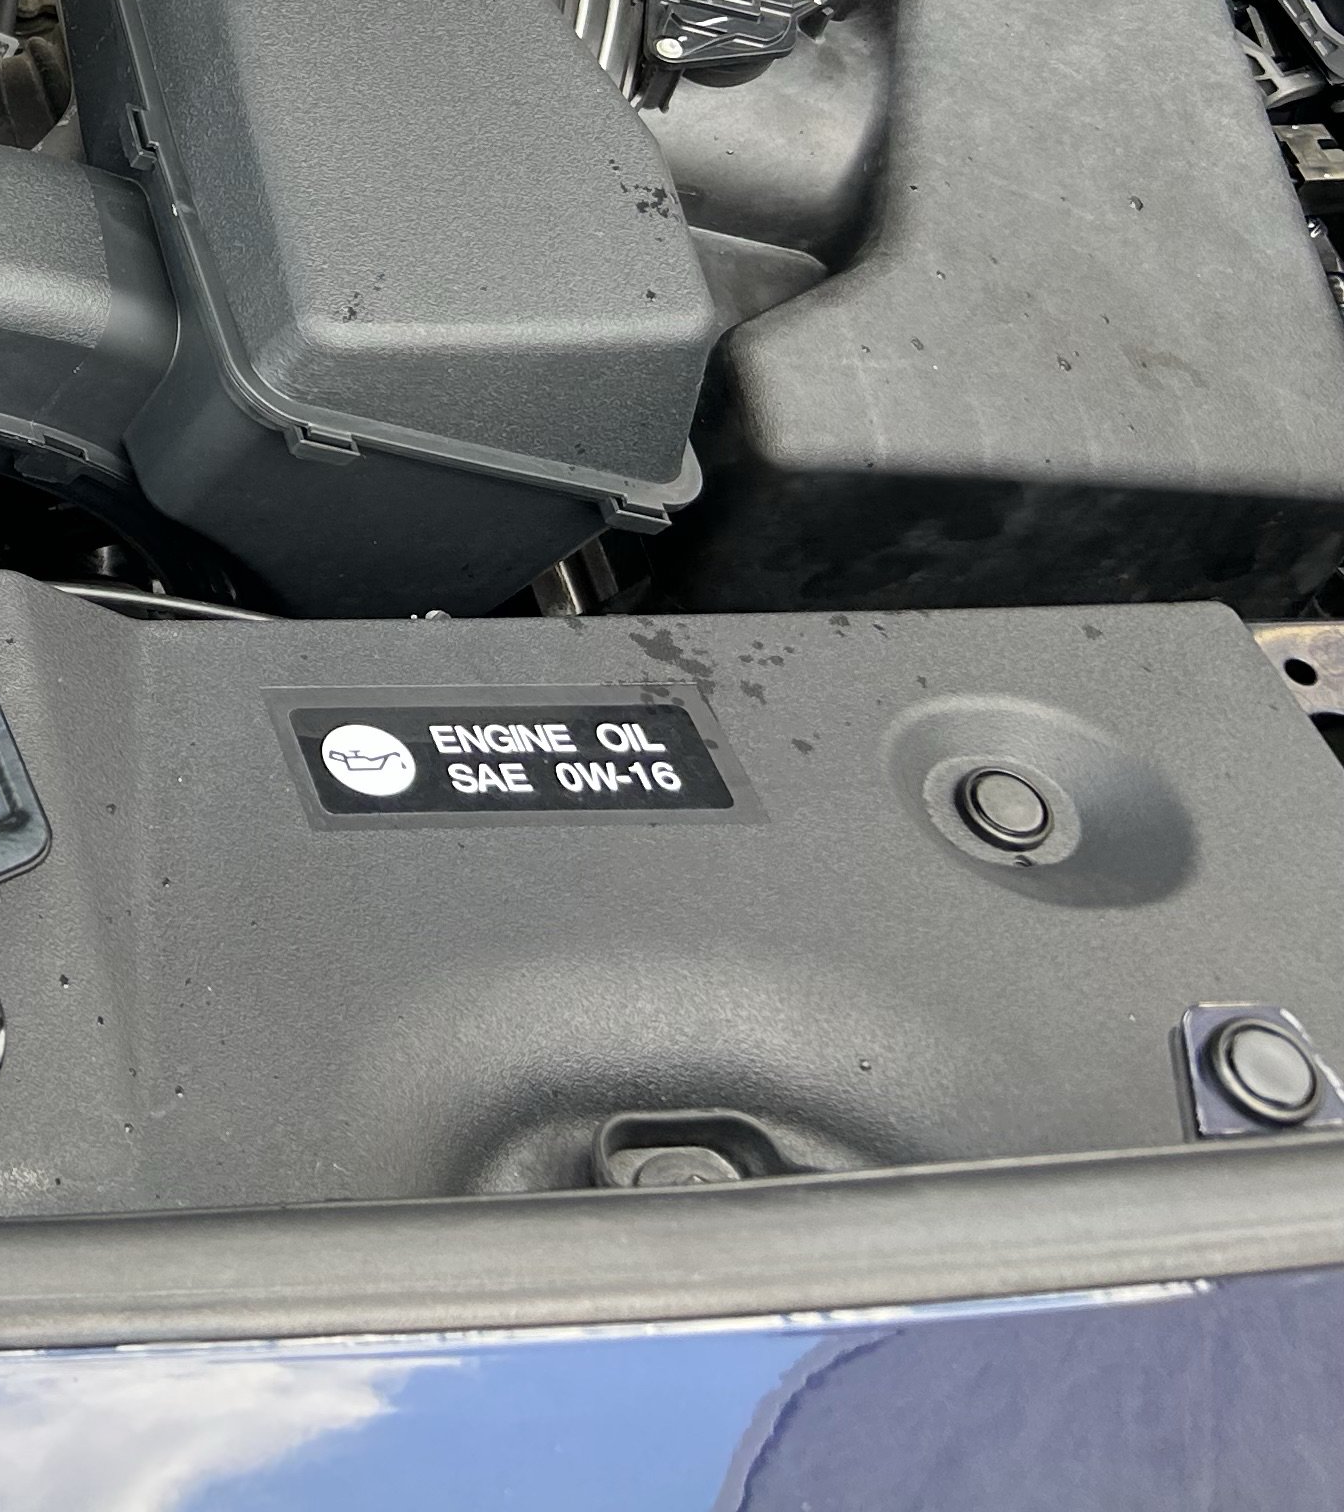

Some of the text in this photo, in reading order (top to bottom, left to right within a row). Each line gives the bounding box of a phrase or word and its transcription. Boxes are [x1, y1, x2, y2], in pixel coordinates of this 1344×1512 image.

[428, 722, 666, 755] ENGINE OIL
[447, 760, 683, 795] SAE 0W-16
